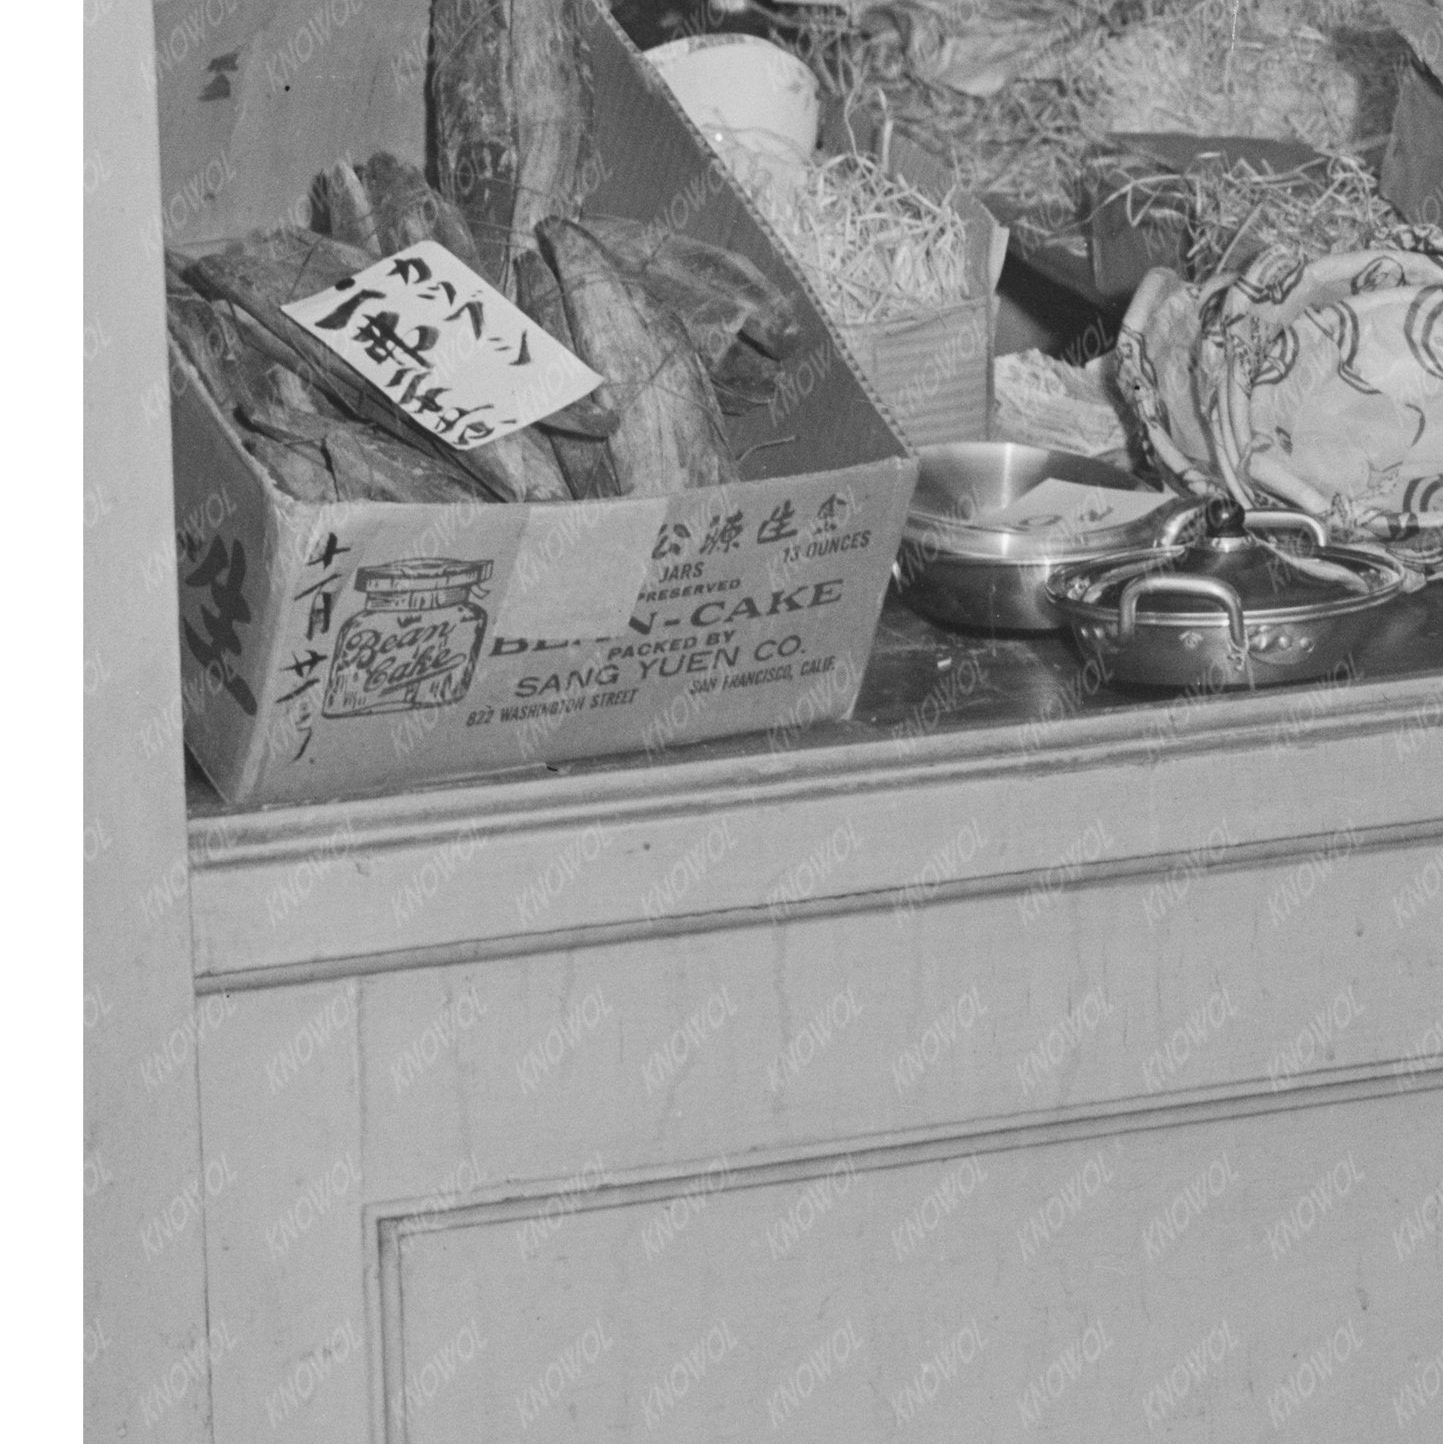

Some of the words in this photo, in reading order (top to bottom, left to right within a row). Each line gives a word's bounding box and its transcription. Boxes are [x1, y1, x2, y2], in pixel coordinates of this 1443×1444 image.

[805, 529, 872, 560] OUNCES
[658, 560, 705, 585] JARS
[344, 619, 456, 670] Bean
[608, 637, 684, 661] PACKED
[691, 629, 737, 651] BY
[364, 646, 467, 696] Cake
[513, 657, 622, 700] SANG
[638, 644, 745, 683] YUEN
[754, 633, 806, 663] CO.
[688, 676, 720, 697] SAN
[466, 705, 494, 728] 822
[499, 693, 586, 725] WASHINGTON
[589, 686, 639, 712] STREET
